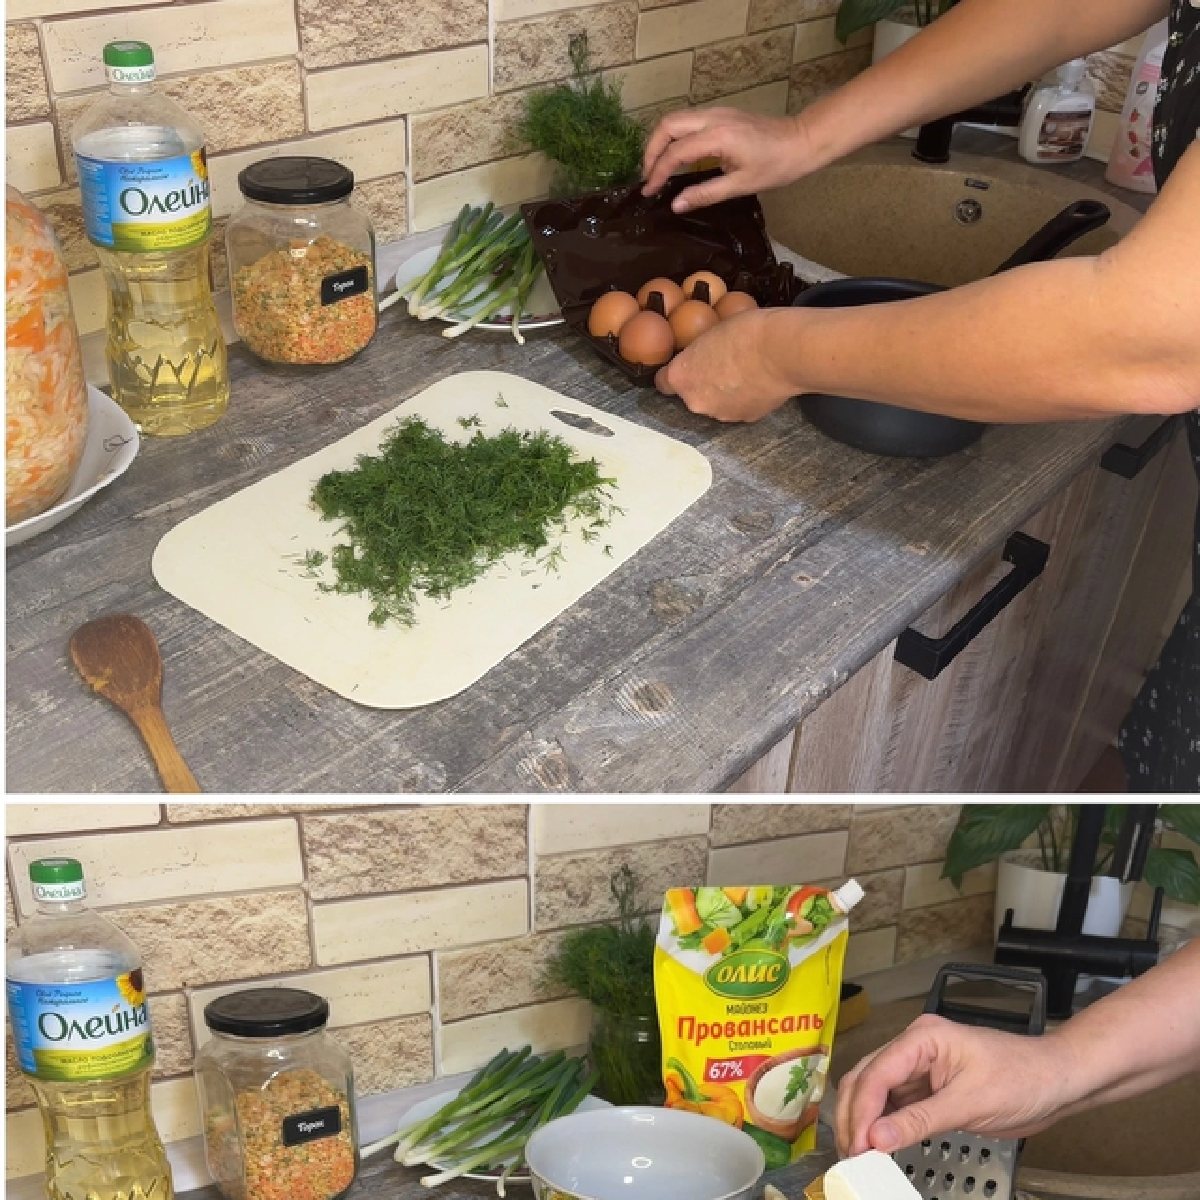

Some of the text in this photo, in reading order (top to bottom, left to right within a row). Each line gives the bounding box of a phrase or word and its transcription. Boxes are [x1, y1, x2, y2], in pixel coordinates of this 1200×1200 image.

[120, 179, 211, 216] Олейн
[677, 1013, 824, 1046] Провансаль
[709, 1060, 743, 1080] 67%
